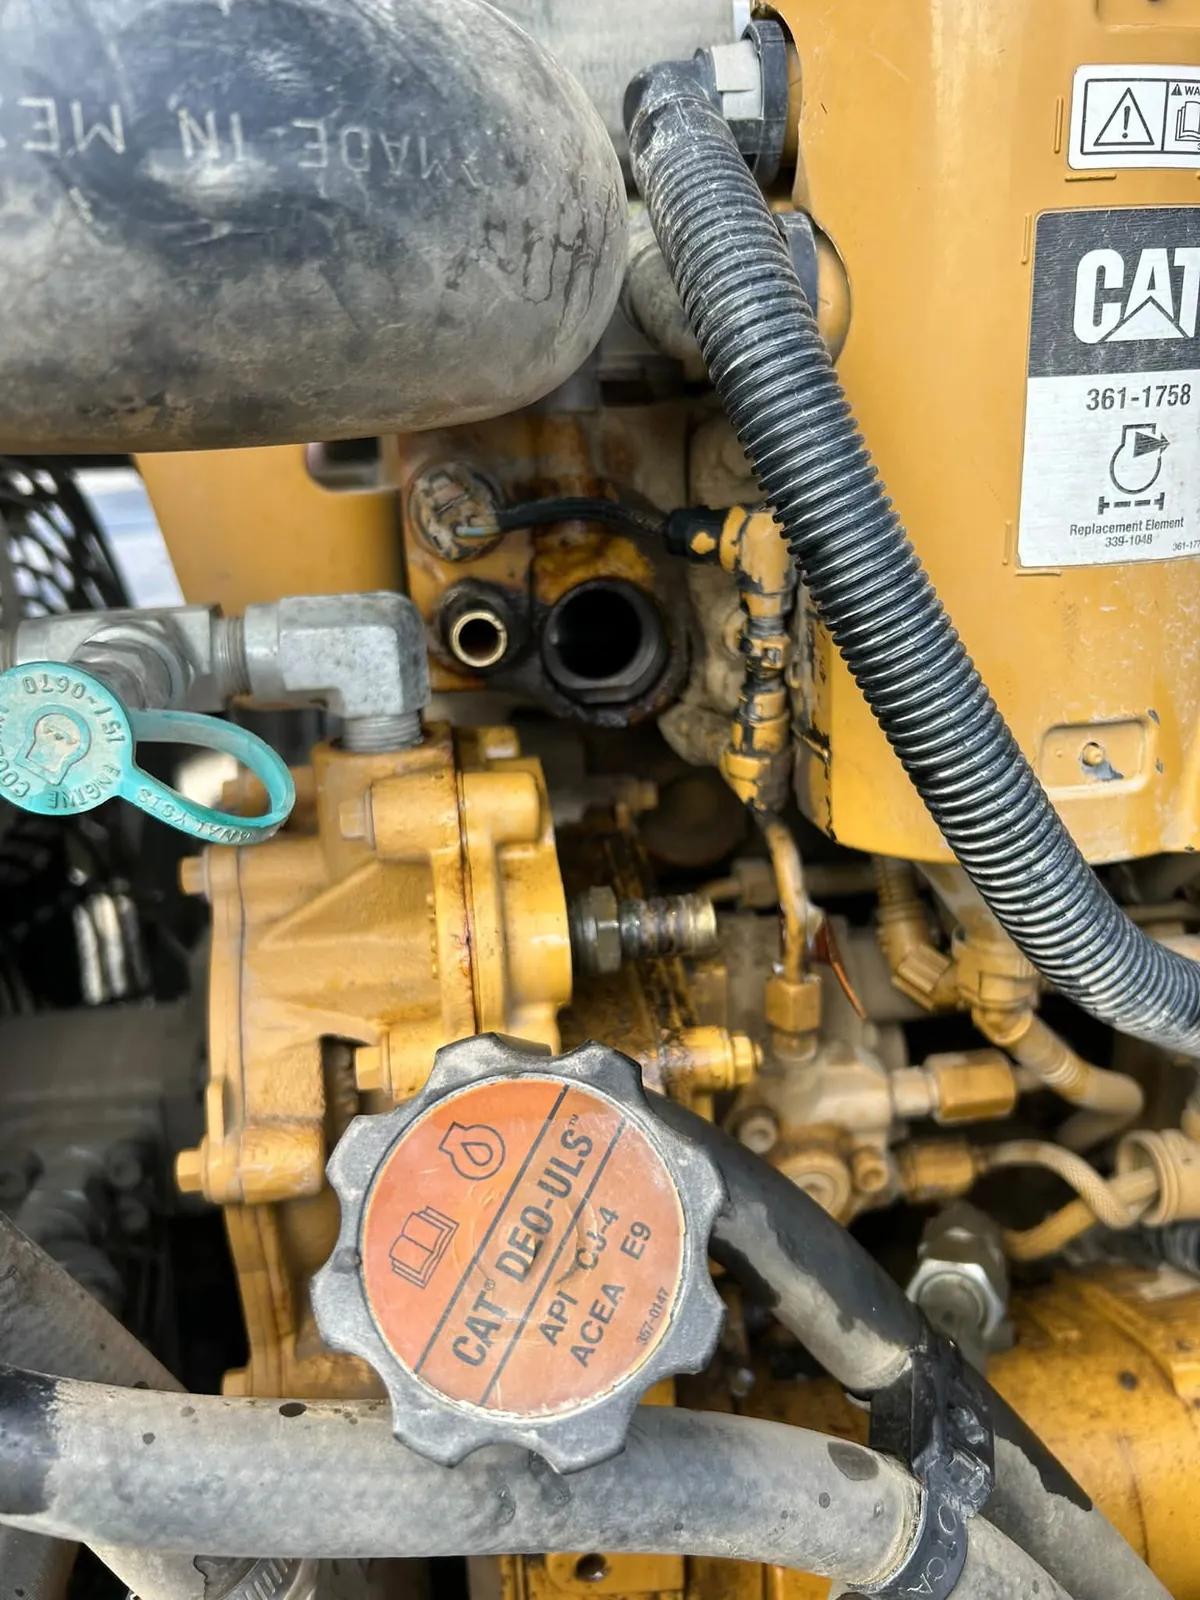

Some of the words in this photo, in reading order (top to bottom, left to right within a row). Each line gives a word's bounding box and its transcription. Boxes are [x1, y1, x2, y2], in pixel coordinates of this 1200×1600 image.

[0, 96, 127, 156] ME
[179, 107, 246, 162] IN
[291, 118, 453, 186] MADE
[1073, 247, 1200, 344] CAT
[1085, 383, 1192, 411] 361-1758
[1069, 519, 1143, 537] Replacement
[1145, 516, 1184, 531] Element
[1104, 533, 1153, 548] 339-1048
[48, 764, 121, 810] ENGINE
[539, 1291, 578, 1346] API
[575, 1206, 619, 1271] CJ-4
[569, 1283, 625, 1368] ACEA
[620, 1221, 652, 1261] E9
[636, 1286, 670, 1347] 357-0147
